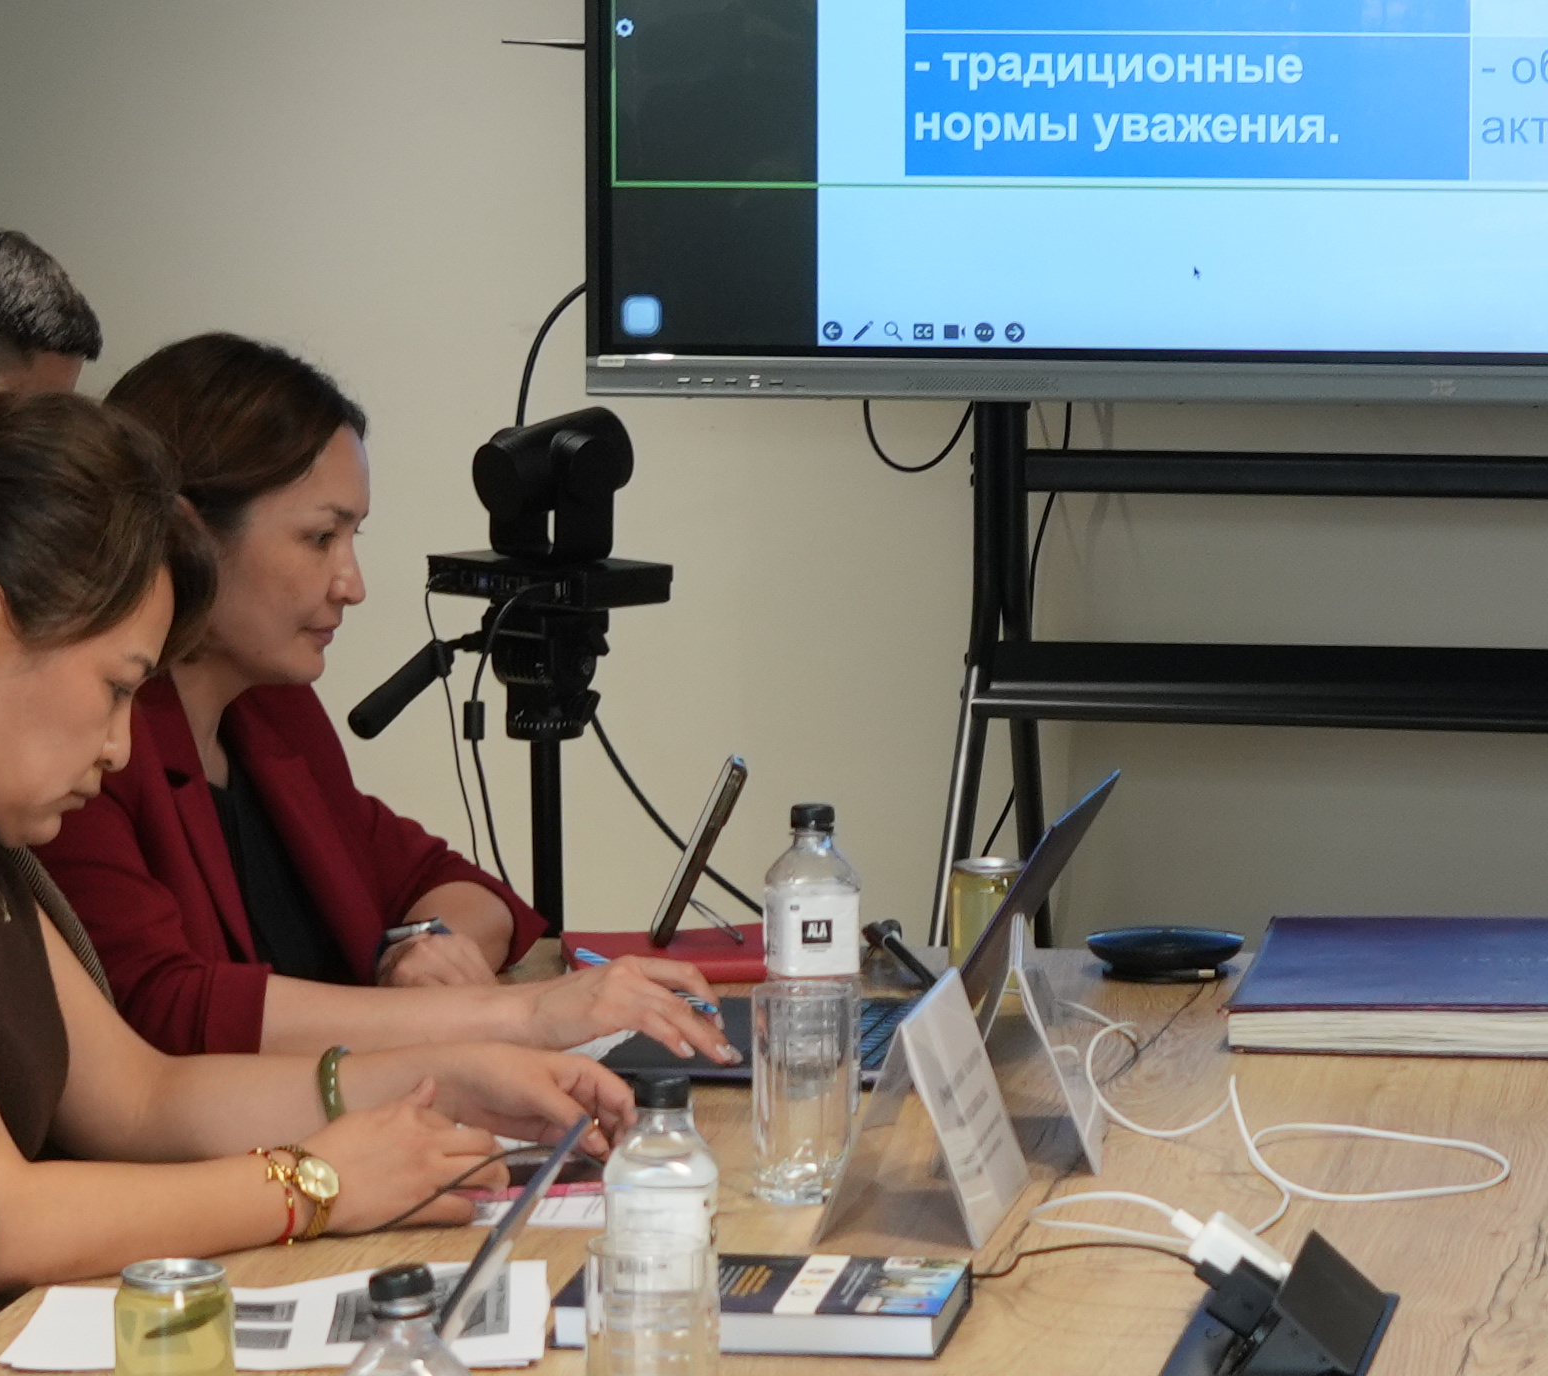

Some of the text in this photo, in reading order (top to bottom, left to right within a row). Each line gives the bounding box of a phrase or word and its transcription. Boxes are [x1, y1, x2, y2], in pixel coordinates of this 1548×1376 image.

[942, 52, 1304, 91] традиционные
[915, 112, 1339, 152] нормы уважения.
